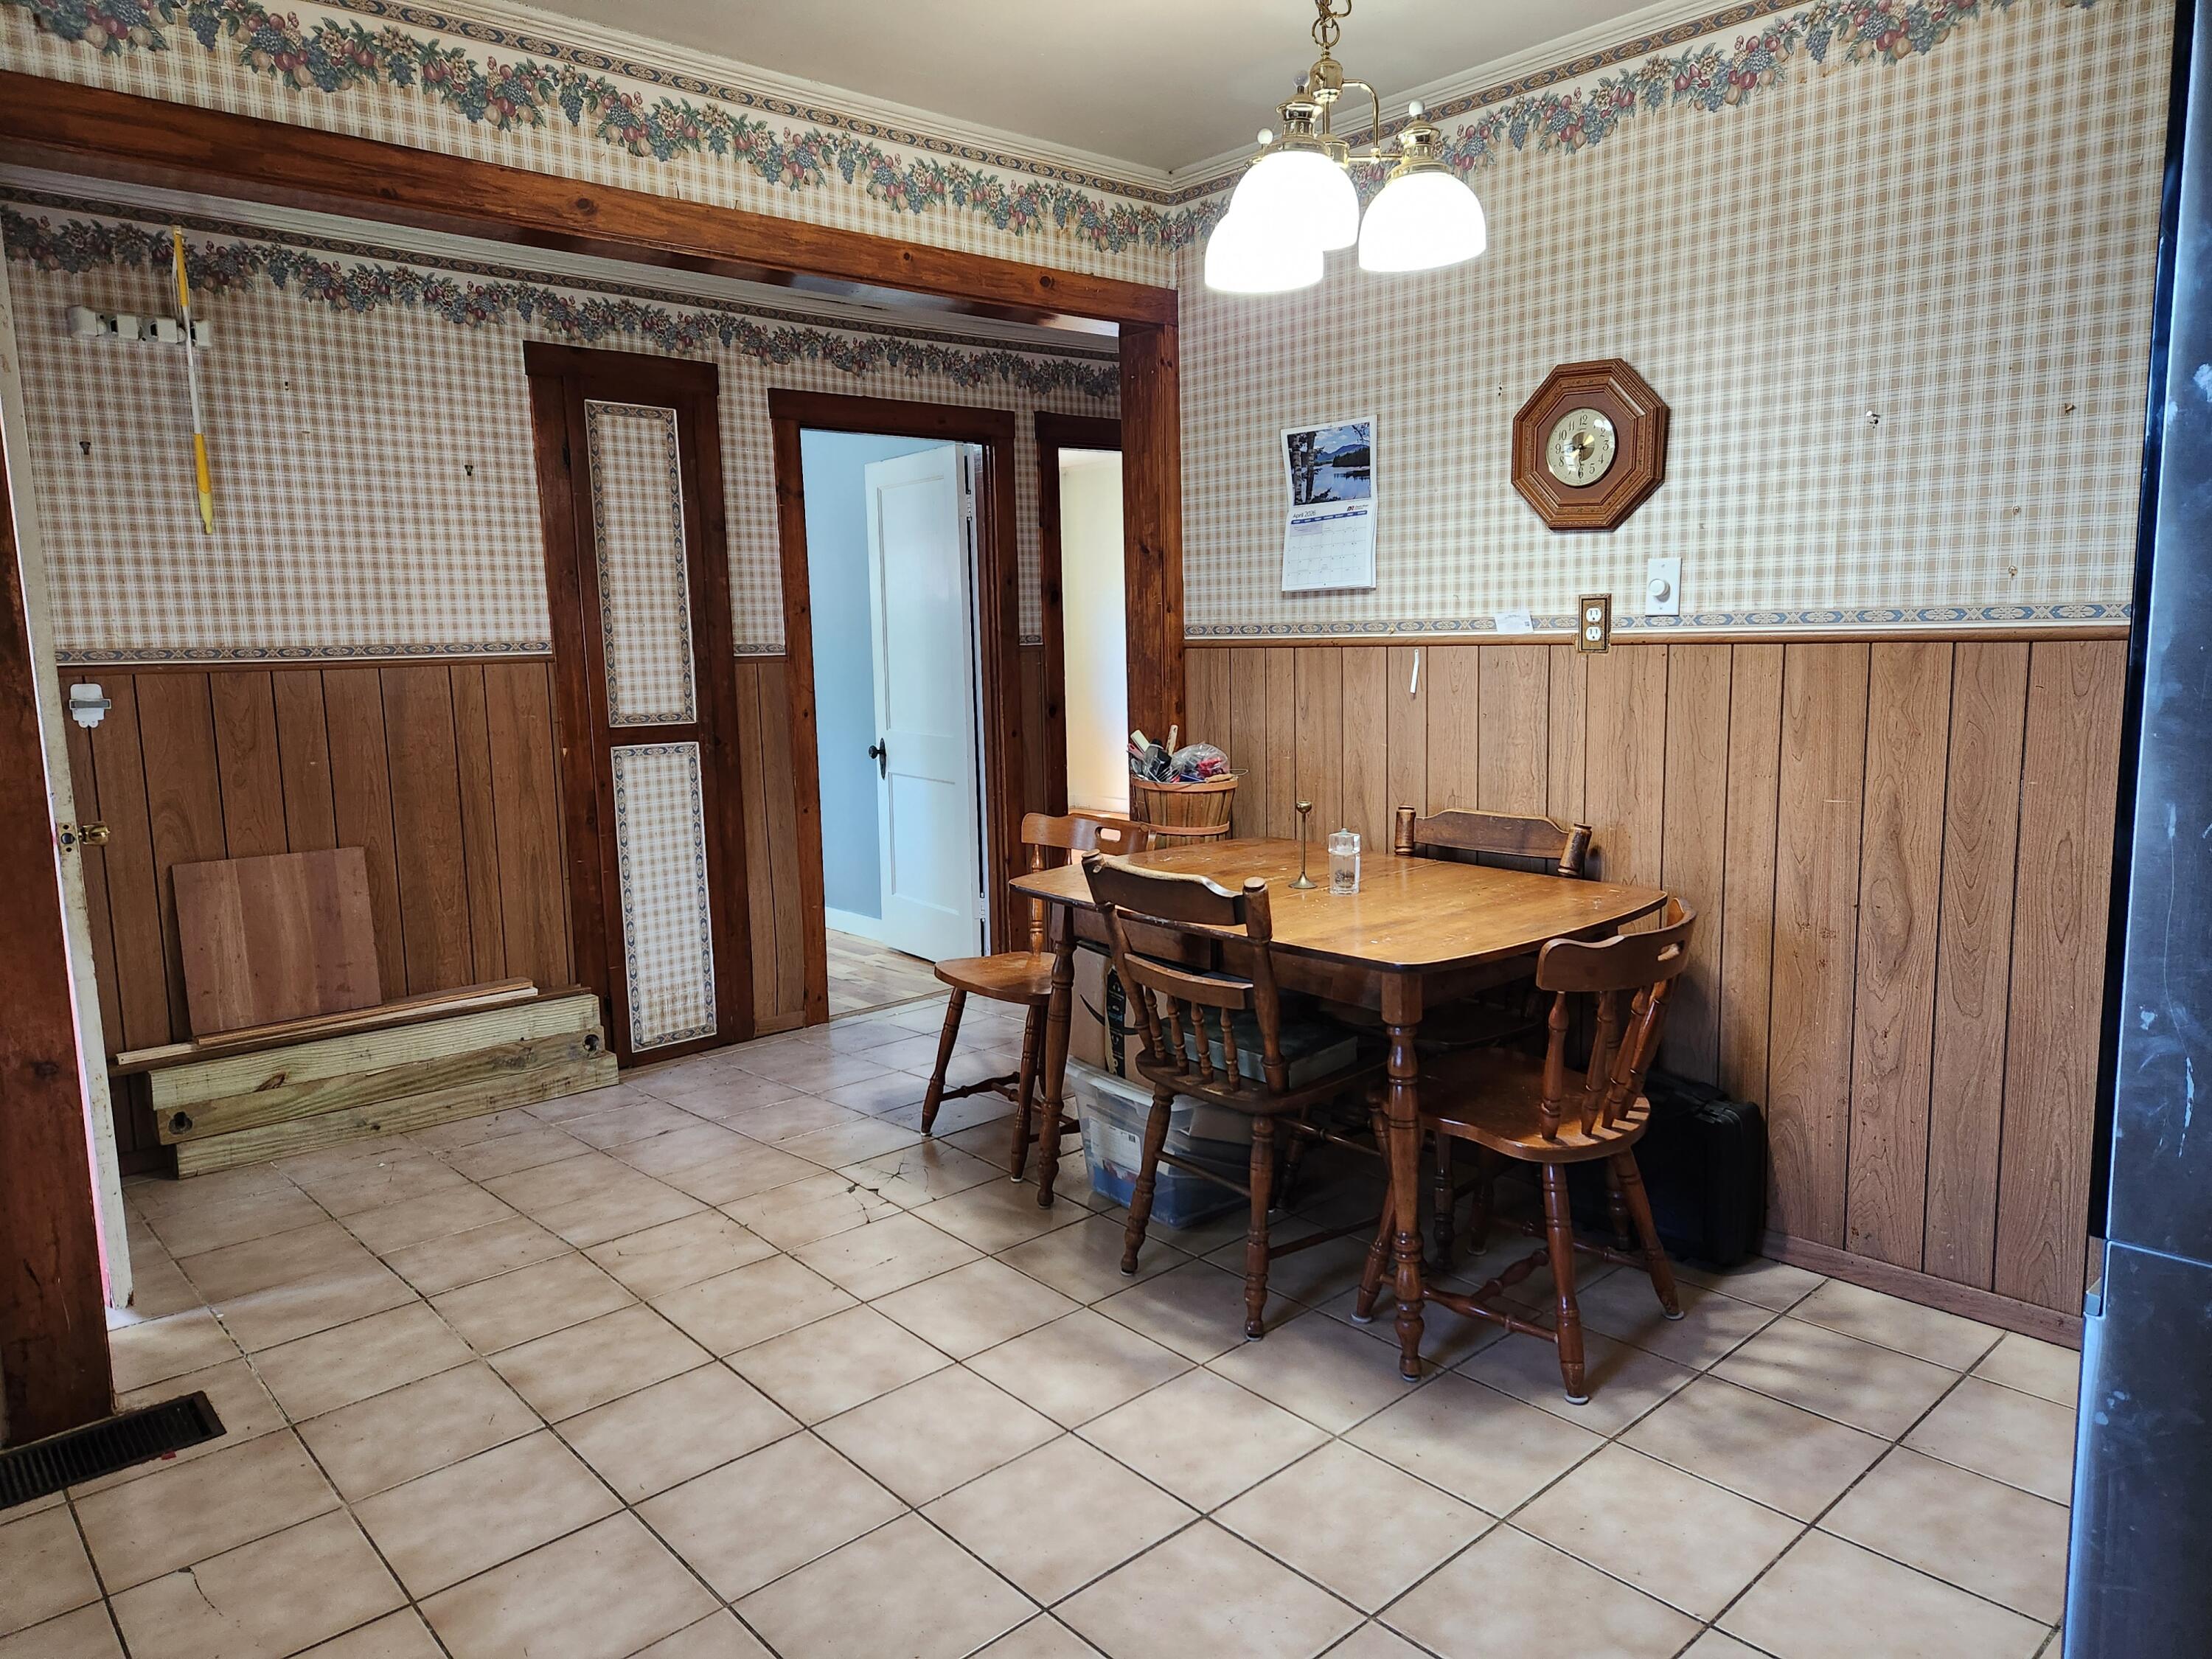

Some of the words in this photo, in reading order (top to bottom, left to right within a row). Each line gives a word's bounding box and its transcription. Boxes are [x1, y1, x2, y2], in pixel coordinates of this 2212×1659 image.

[1579, 414, 1587, 425] 12
[1569, 420, 1574, 431] 11
[1558, 430, 1567, 440] 10
[1600, 428, 1606, 437] 2
[1555, 443, 1562, 454] 9
[1602, 439, 1609, 451] 3
[1559, 456, 1565, 467] 8
[1598, 453, 1604, 464] 4
[1578, 466, 1584, 479] 6
[1589, 463, 1595, 474] 5
